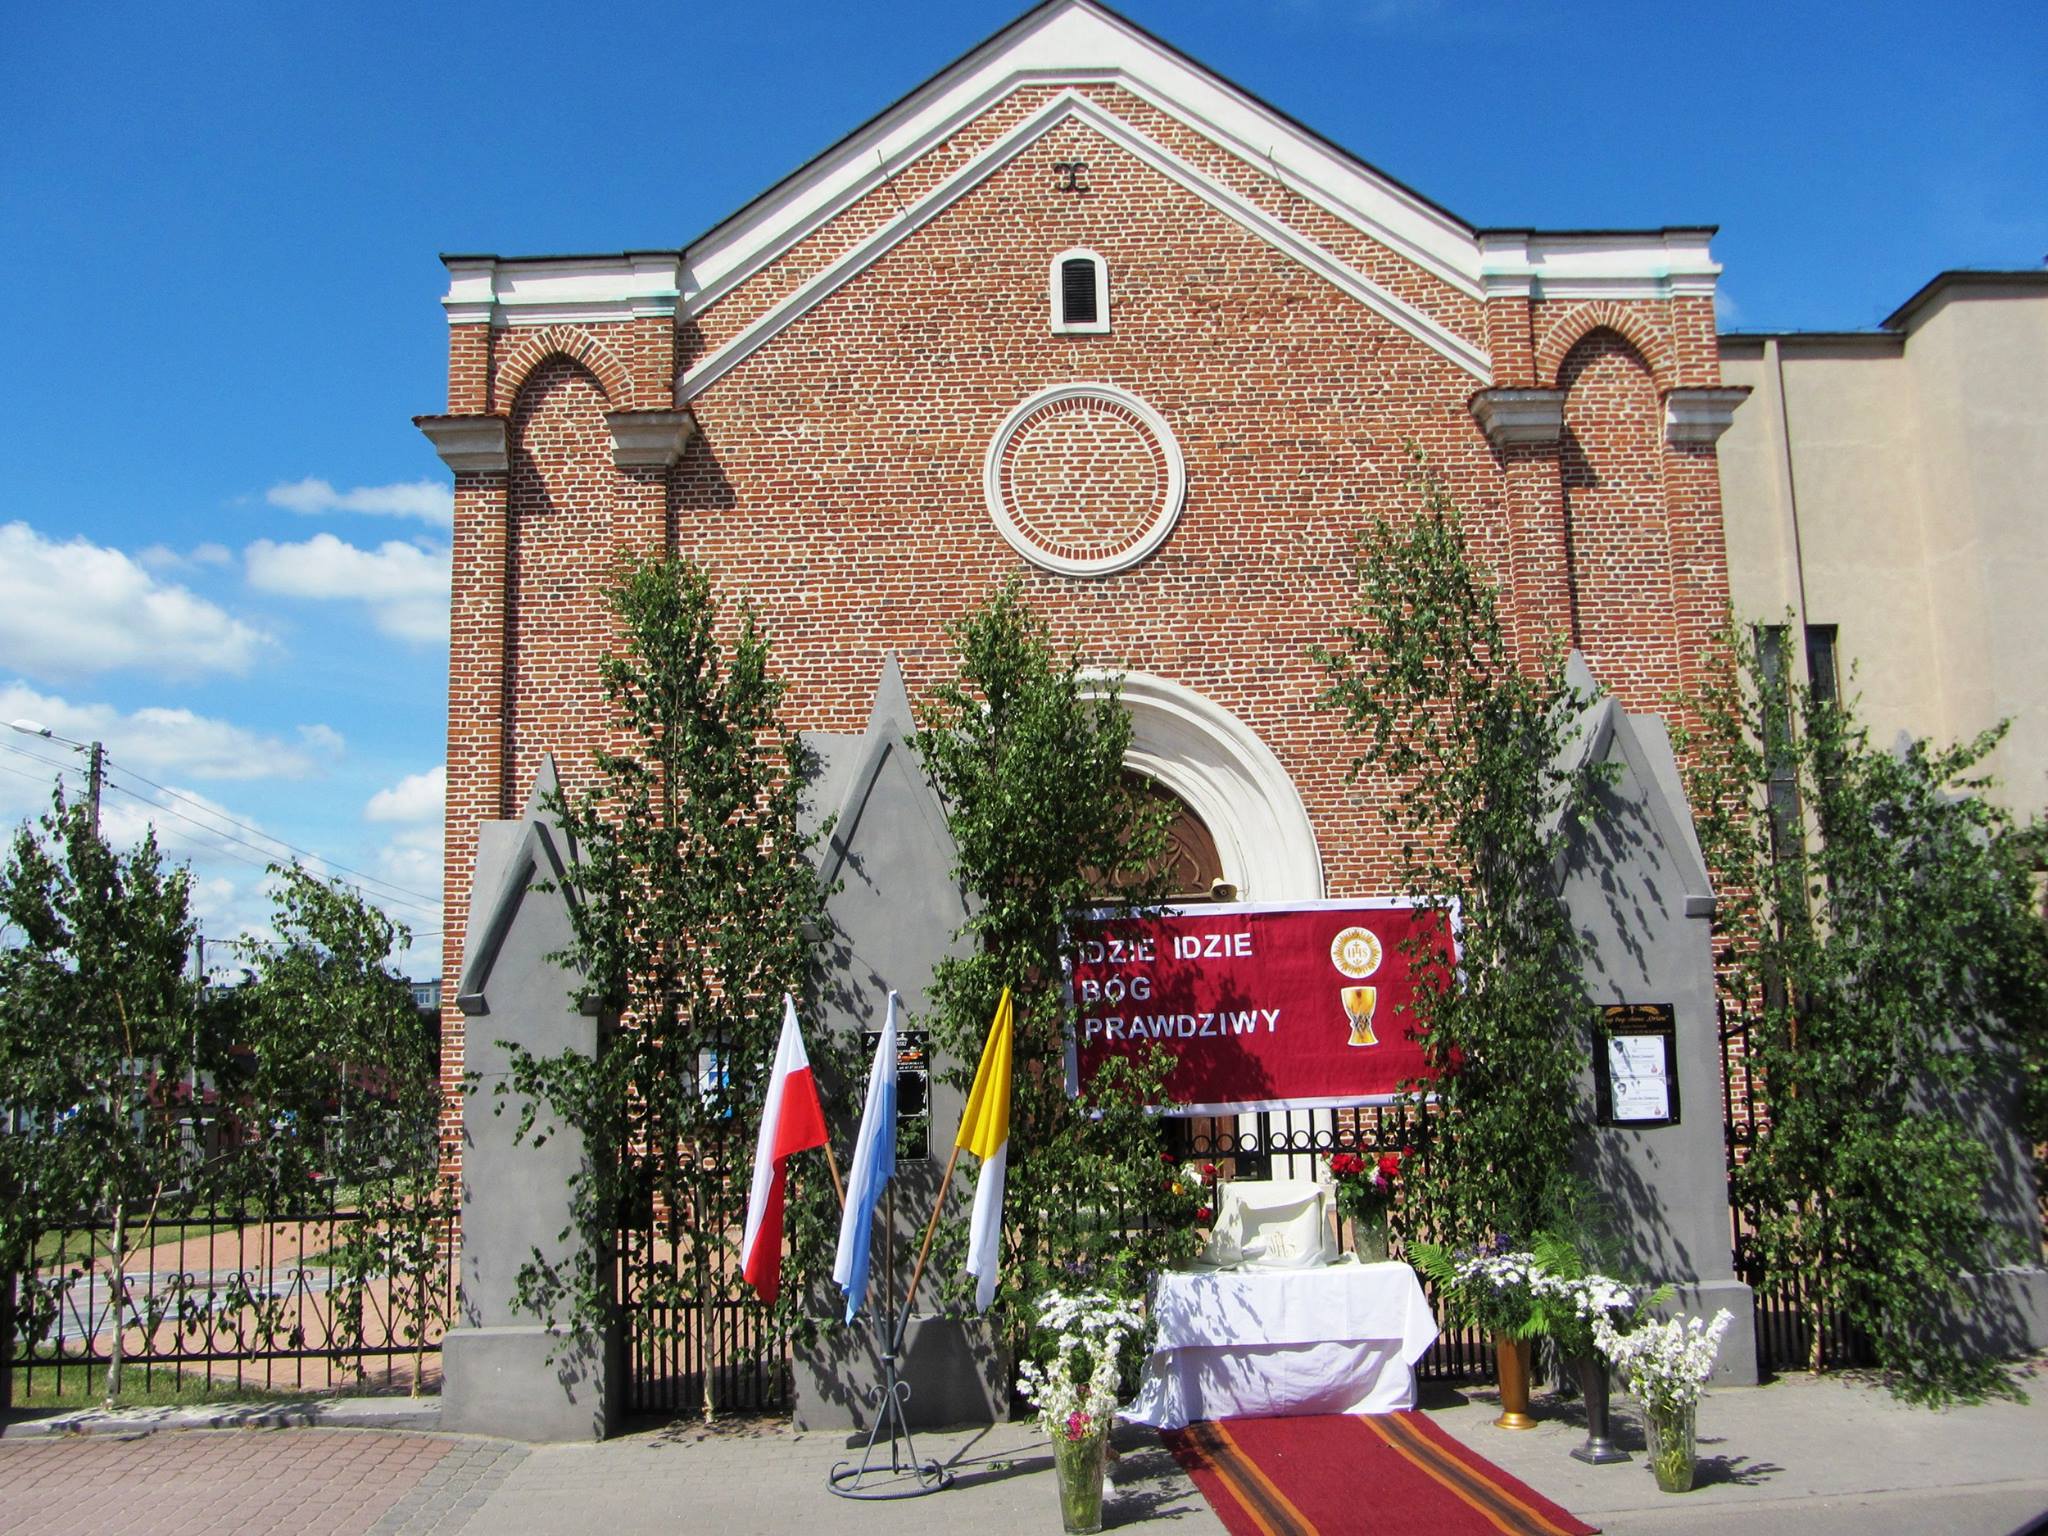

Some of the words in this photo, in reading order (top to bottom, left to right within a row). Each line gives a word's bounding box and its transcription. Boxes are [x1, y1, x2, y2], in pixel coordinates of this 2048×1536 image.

[1174, 933, 1252, 959] IDZIE
[1082, 974, 1151, 1002] BÓG
[1085, 1009, 1280, 1041] PRAWDZIWY
